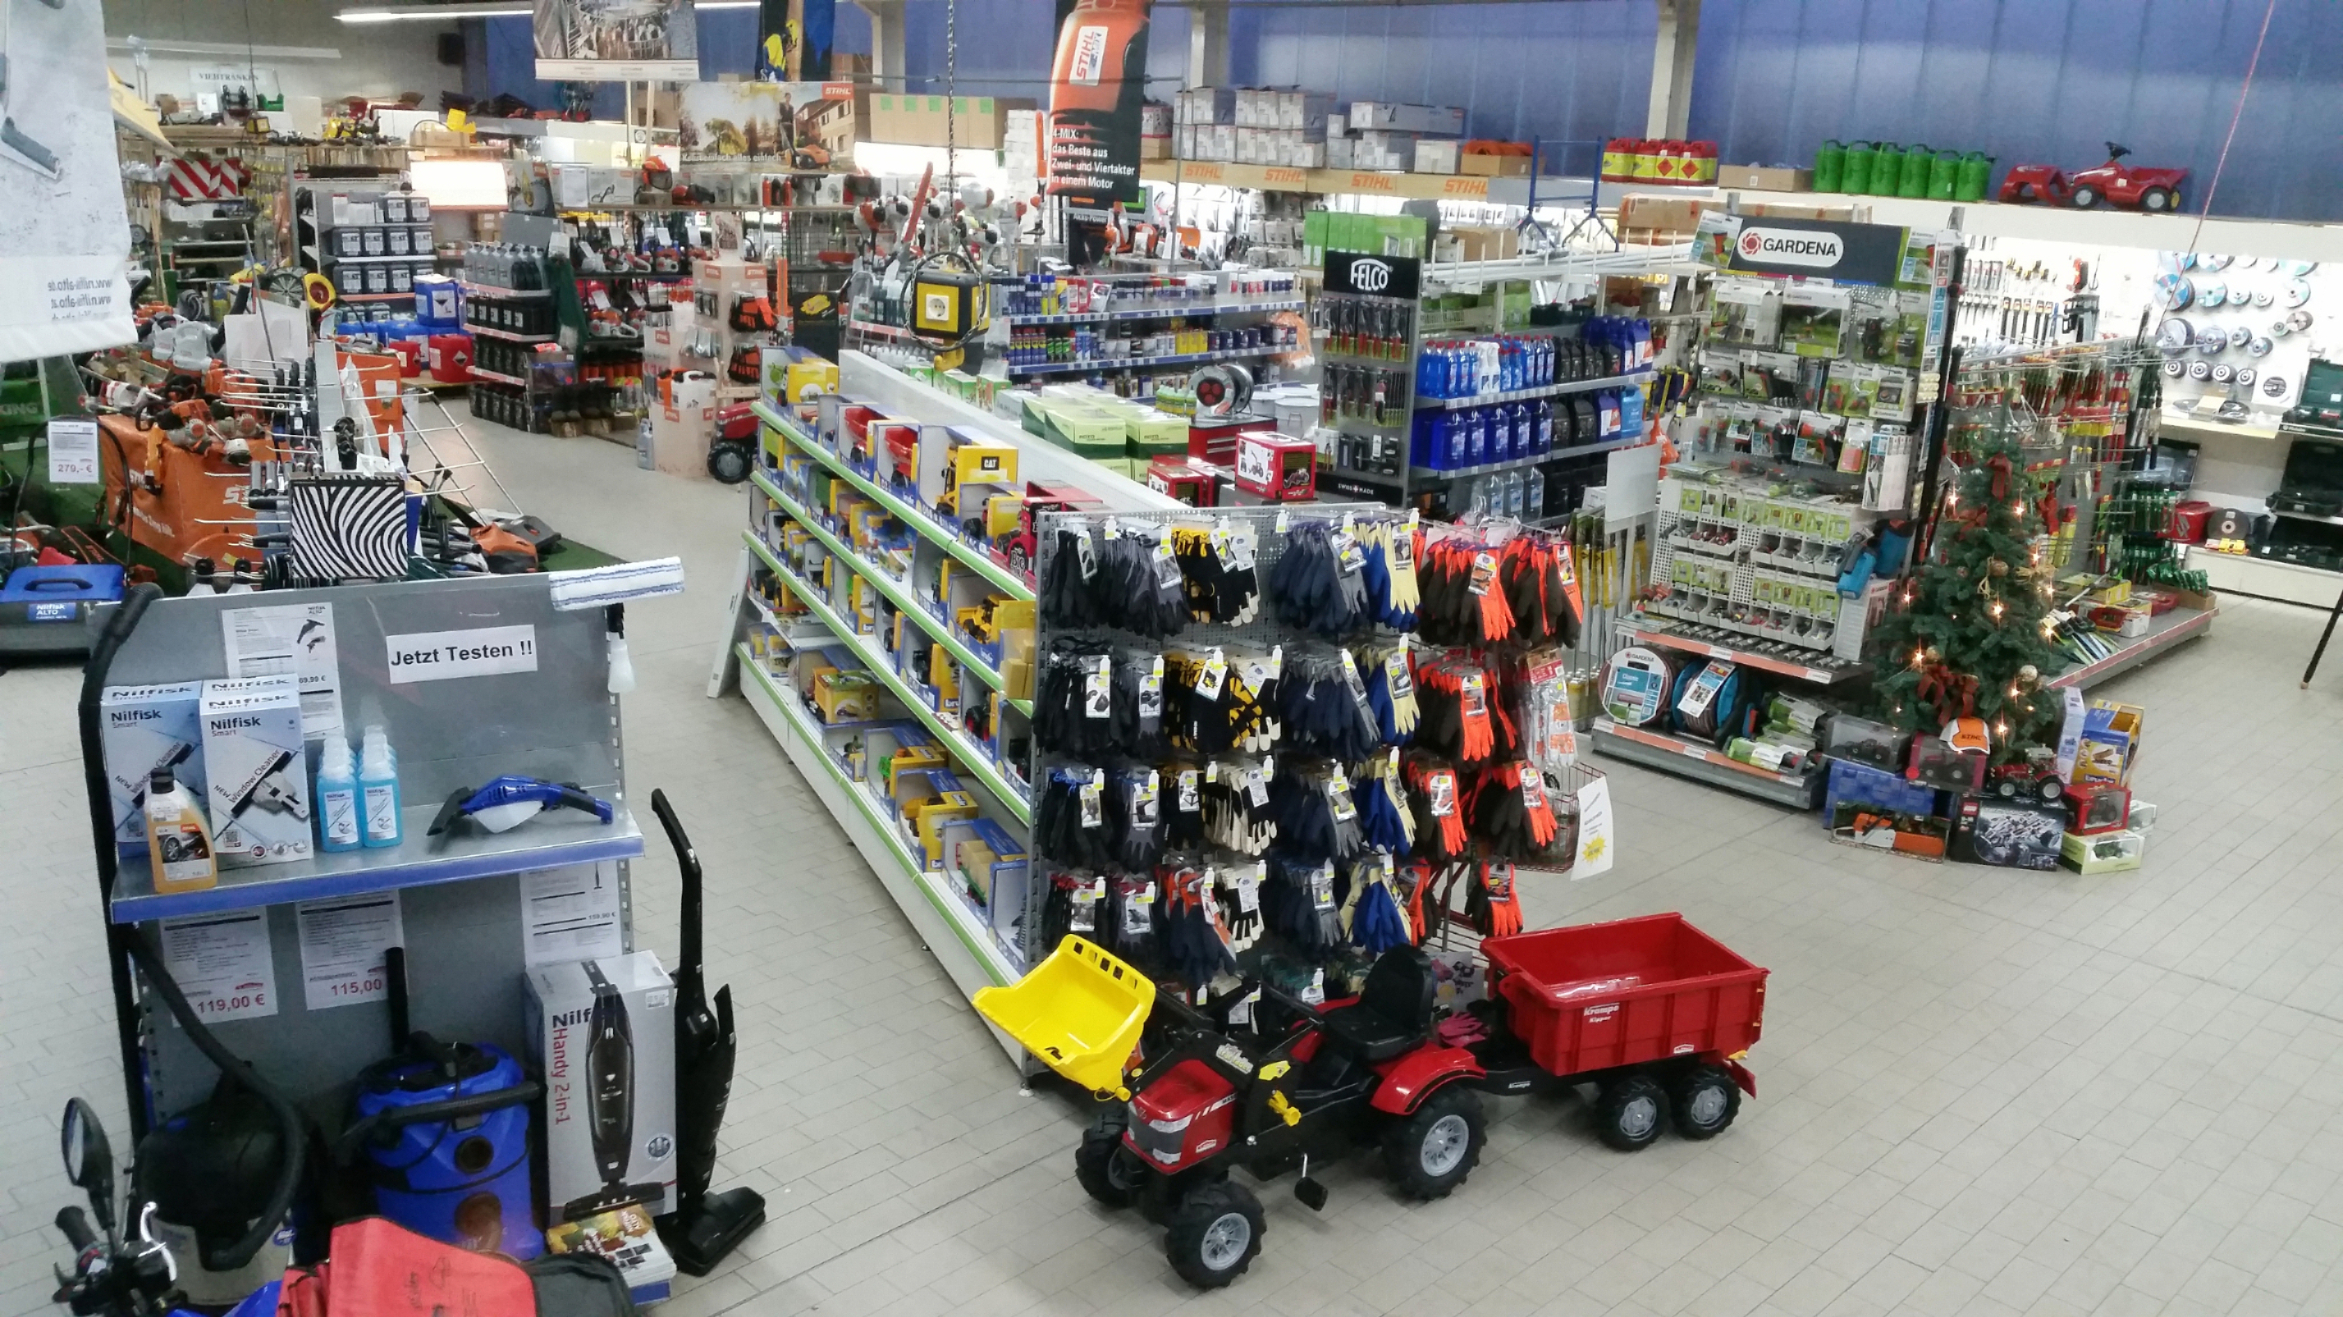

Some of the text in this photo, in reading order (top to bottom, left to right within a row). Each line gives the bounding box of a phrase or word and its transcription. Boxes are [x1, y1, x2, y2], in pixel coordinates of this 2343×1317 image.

[1076, 31, 1095, 80] STIHL
[825, 87, 851, 95] STIHL
[1053, 128, 1079, 138] 4-MIX:
[1052, 143, 1108, 157] das Beste aus
[1051, 158, 1135, 175] Zwei- und Viertakter
[1185, 165, 1222, 179] STIHL
[1051, 173, 1114, 189] in einem Motor
[1264, 168, 1304, 183] STIHL
[1351, 173, 1393, 190] STIHL
[1444, 178, 1488, 195] STIHL
[1763, 238, 1837, 257] GARDENA
[1350, 258, 1389, 291] FELCO
[86, 464, 92, 473] €
[984, 459, 997, 468] CAT
[391, 640, 533, 666] Jetzt Testen !!
[112, 686, 193, 698] Nilfisk
[111, 709, 162, 722] Nilfisk
[112, 721, 137, 729] Smart
[211, 716, 261, 731] Nilfisk
[211, 729, 237, 737] Smart
[114, 775, 132, 789] NEW
[229, 749, 281, 804] Window Cleaner
[213, 785, 232, 798] NEW
[331, 978, 383, 996] 115,00
[198, 994, 266, 1014] 119,00 €
[551, 1028, 570, 1125] Handy 2-in-1
